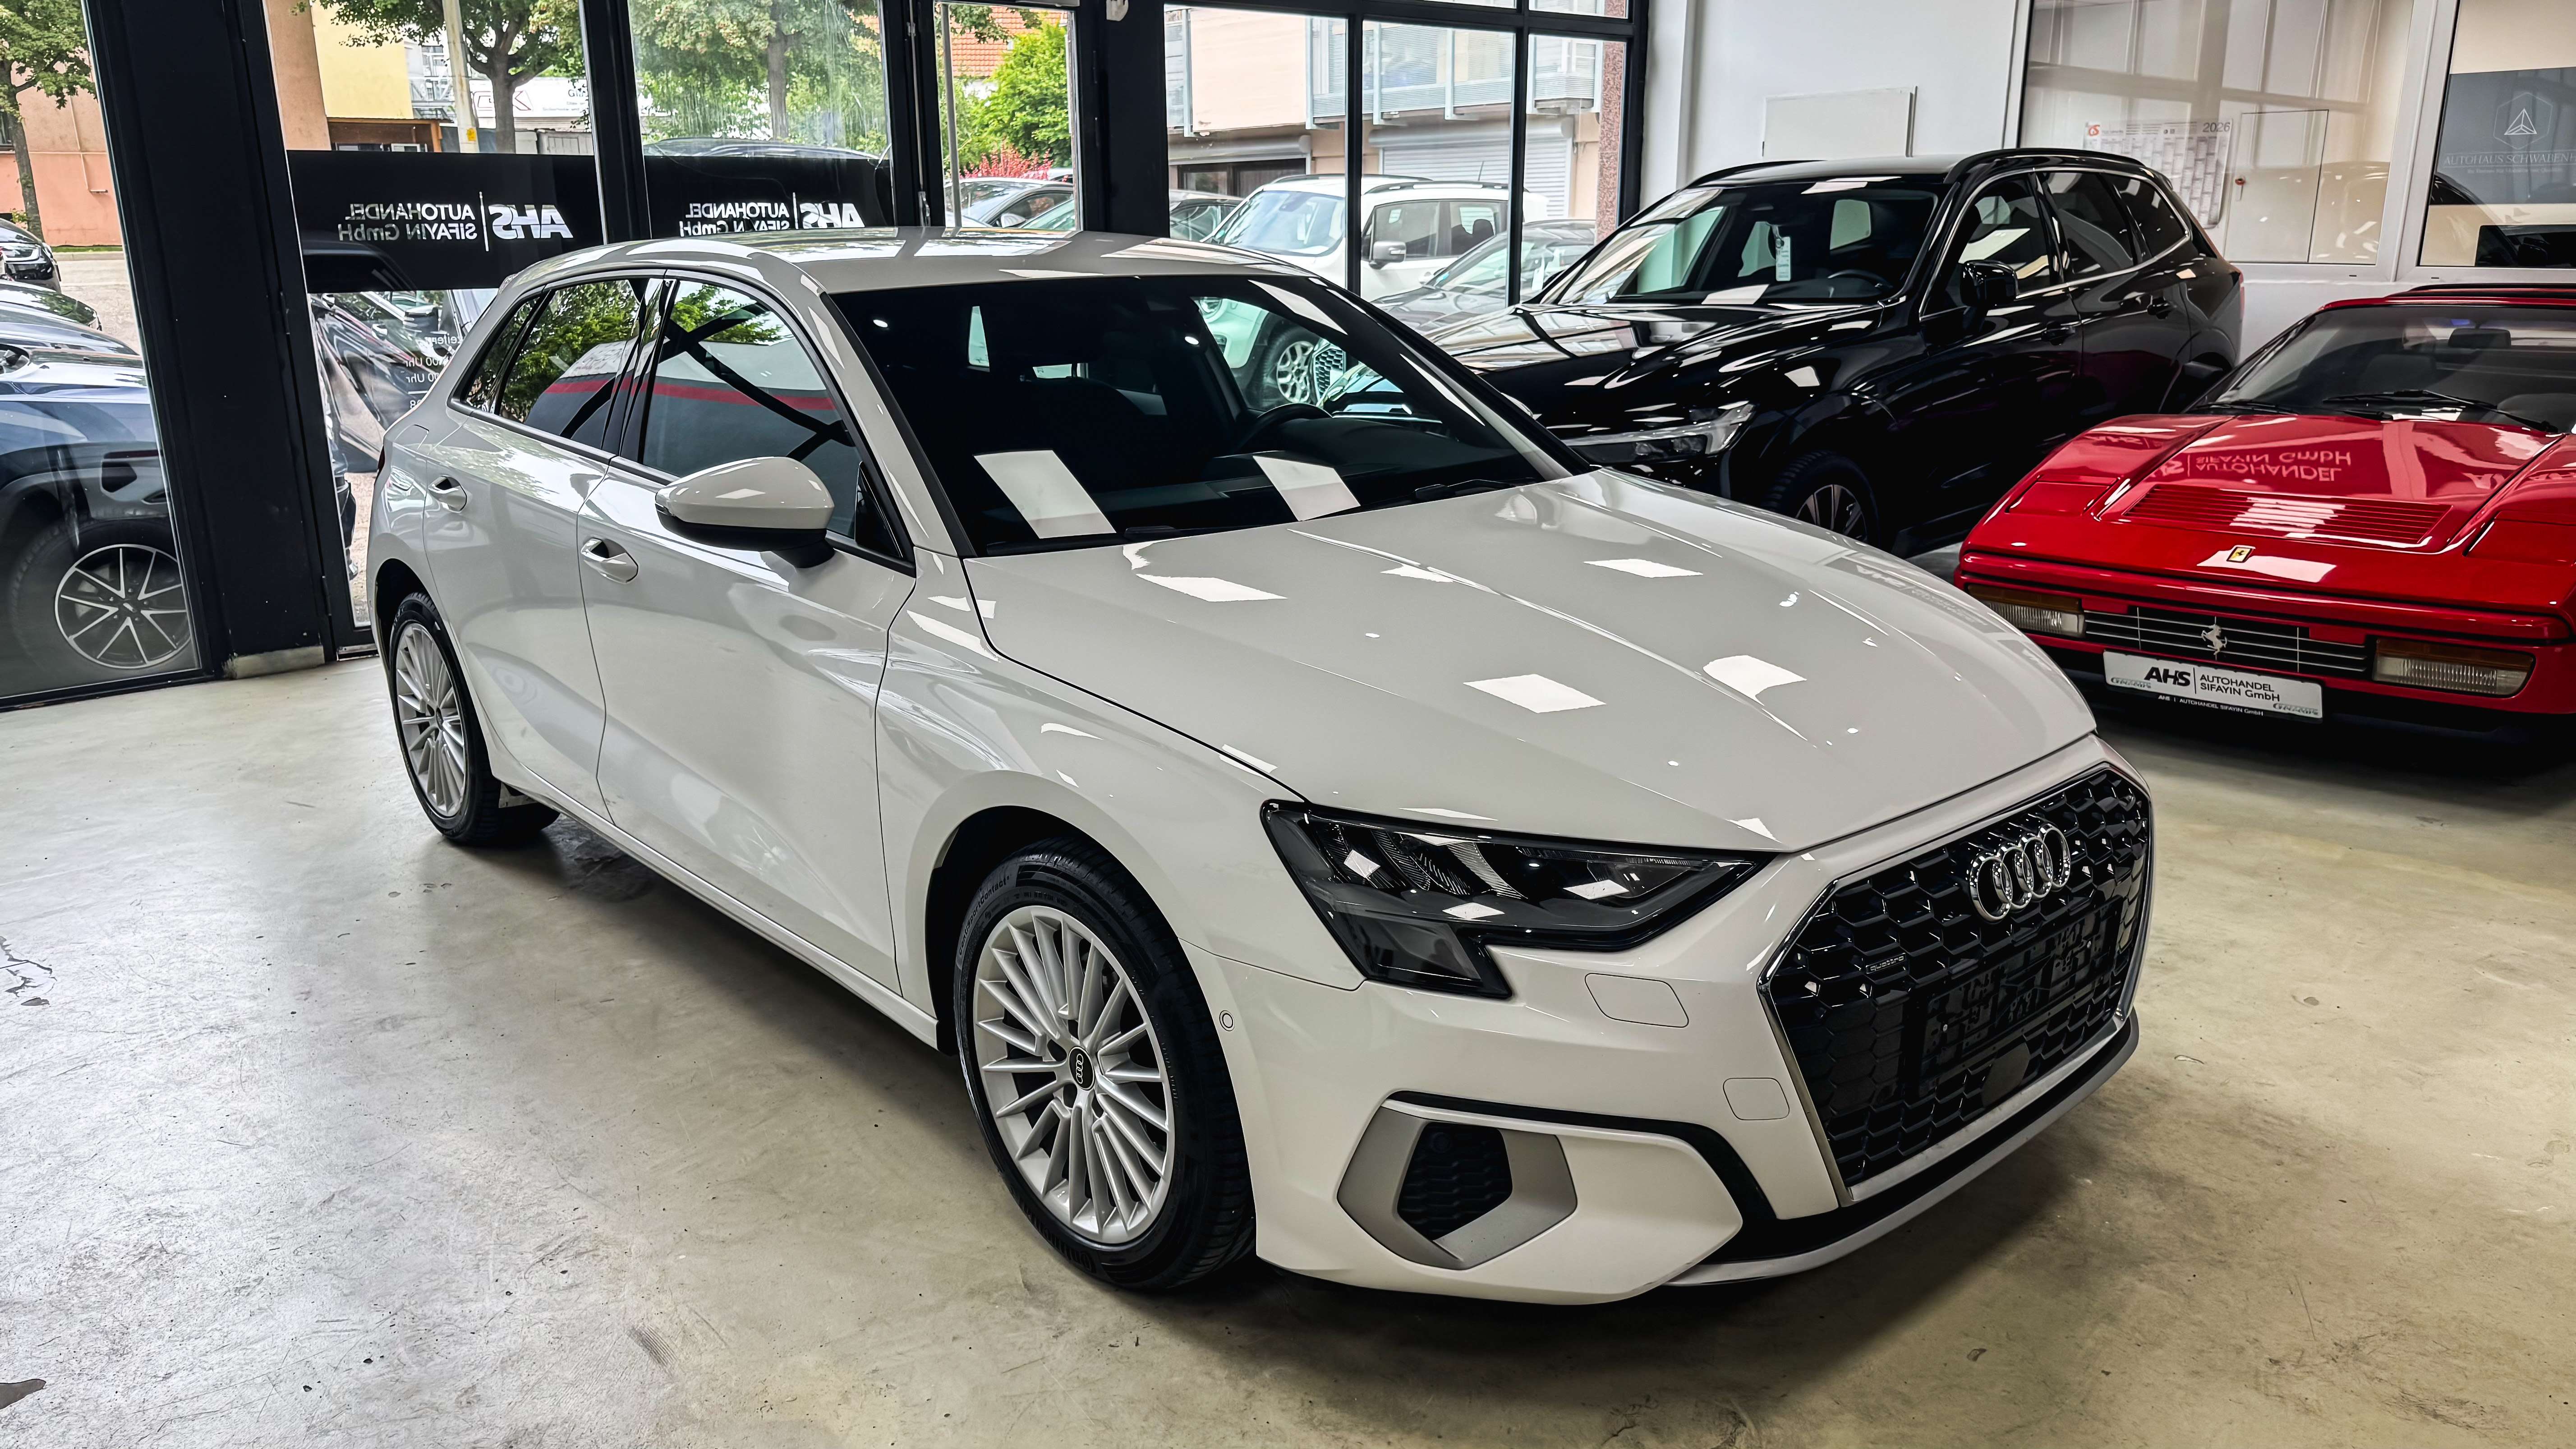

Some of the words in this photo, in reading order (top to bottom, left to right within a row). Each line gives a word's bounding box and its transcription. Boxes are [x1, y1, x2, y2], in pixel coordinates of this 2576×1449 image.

[2203, 122, 2230, 132] 2026
[2444, 155, 2503, 165] AUTOHAUS
[2144, 667, 2190, 686] AHS
[2199, 674, 2275, 692] AUTOHANDEL
[2200, 682, 2241, 696] SIFAYIN
[2245, 690, 2280, 702] GmbH
[2179, 699, 2219, 709] AUTOHANDEL
[1870, 956, 1904, 971] quattro
